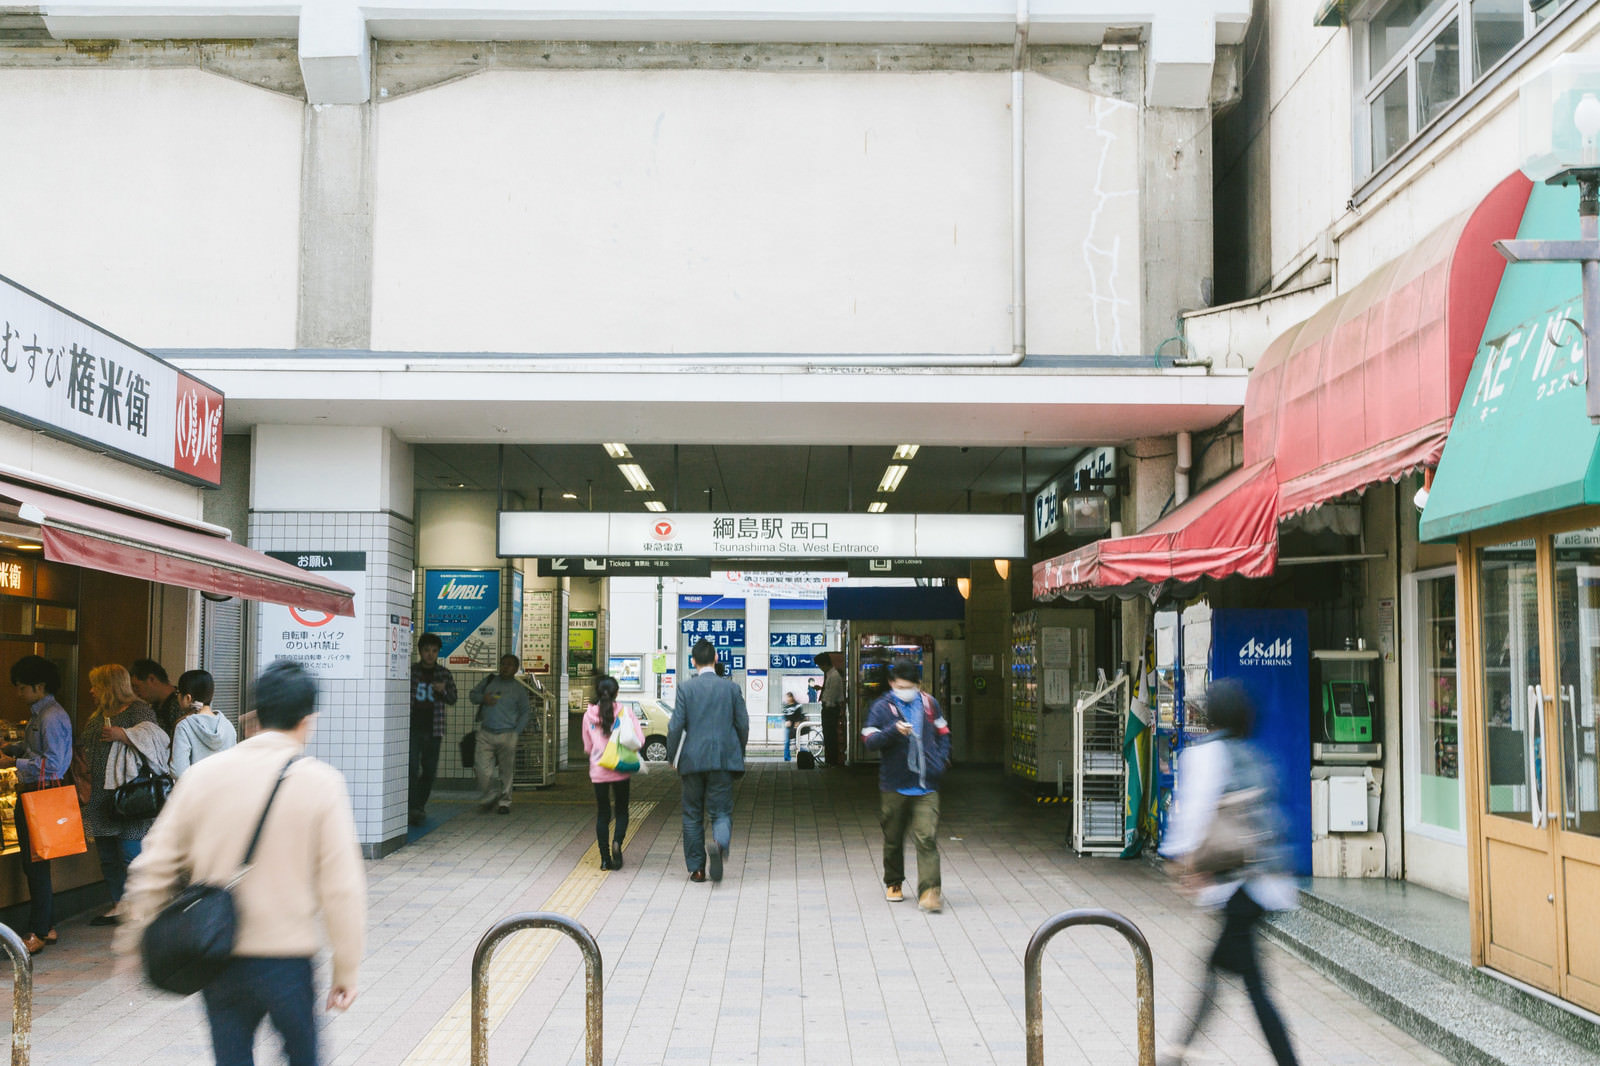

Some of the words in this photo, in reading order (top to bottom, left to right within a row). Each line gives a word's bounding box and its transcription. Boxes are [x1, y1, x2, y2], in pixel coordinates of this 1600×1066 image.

[713, 517, 783, 539] 綱島駅
[791, 521, 828, 539] 西口
[643, 543, 683, 551] 東急電鉄
[713, 542, 776, 552] Tsunashima
[779, 542, 799, 552] Sta.
[803, 542, 830, 552] West
[833, 542, 879, 552] Entrance
[297, 555, 333, 568] お願い
[282, 631, 345, 641] 自転車・バイク
[286, 641, 341, 650] のりいれ禁止
[1239, 637, 1292, 658] Asahi
[1262, 658, 1292, 666] DRINKS
